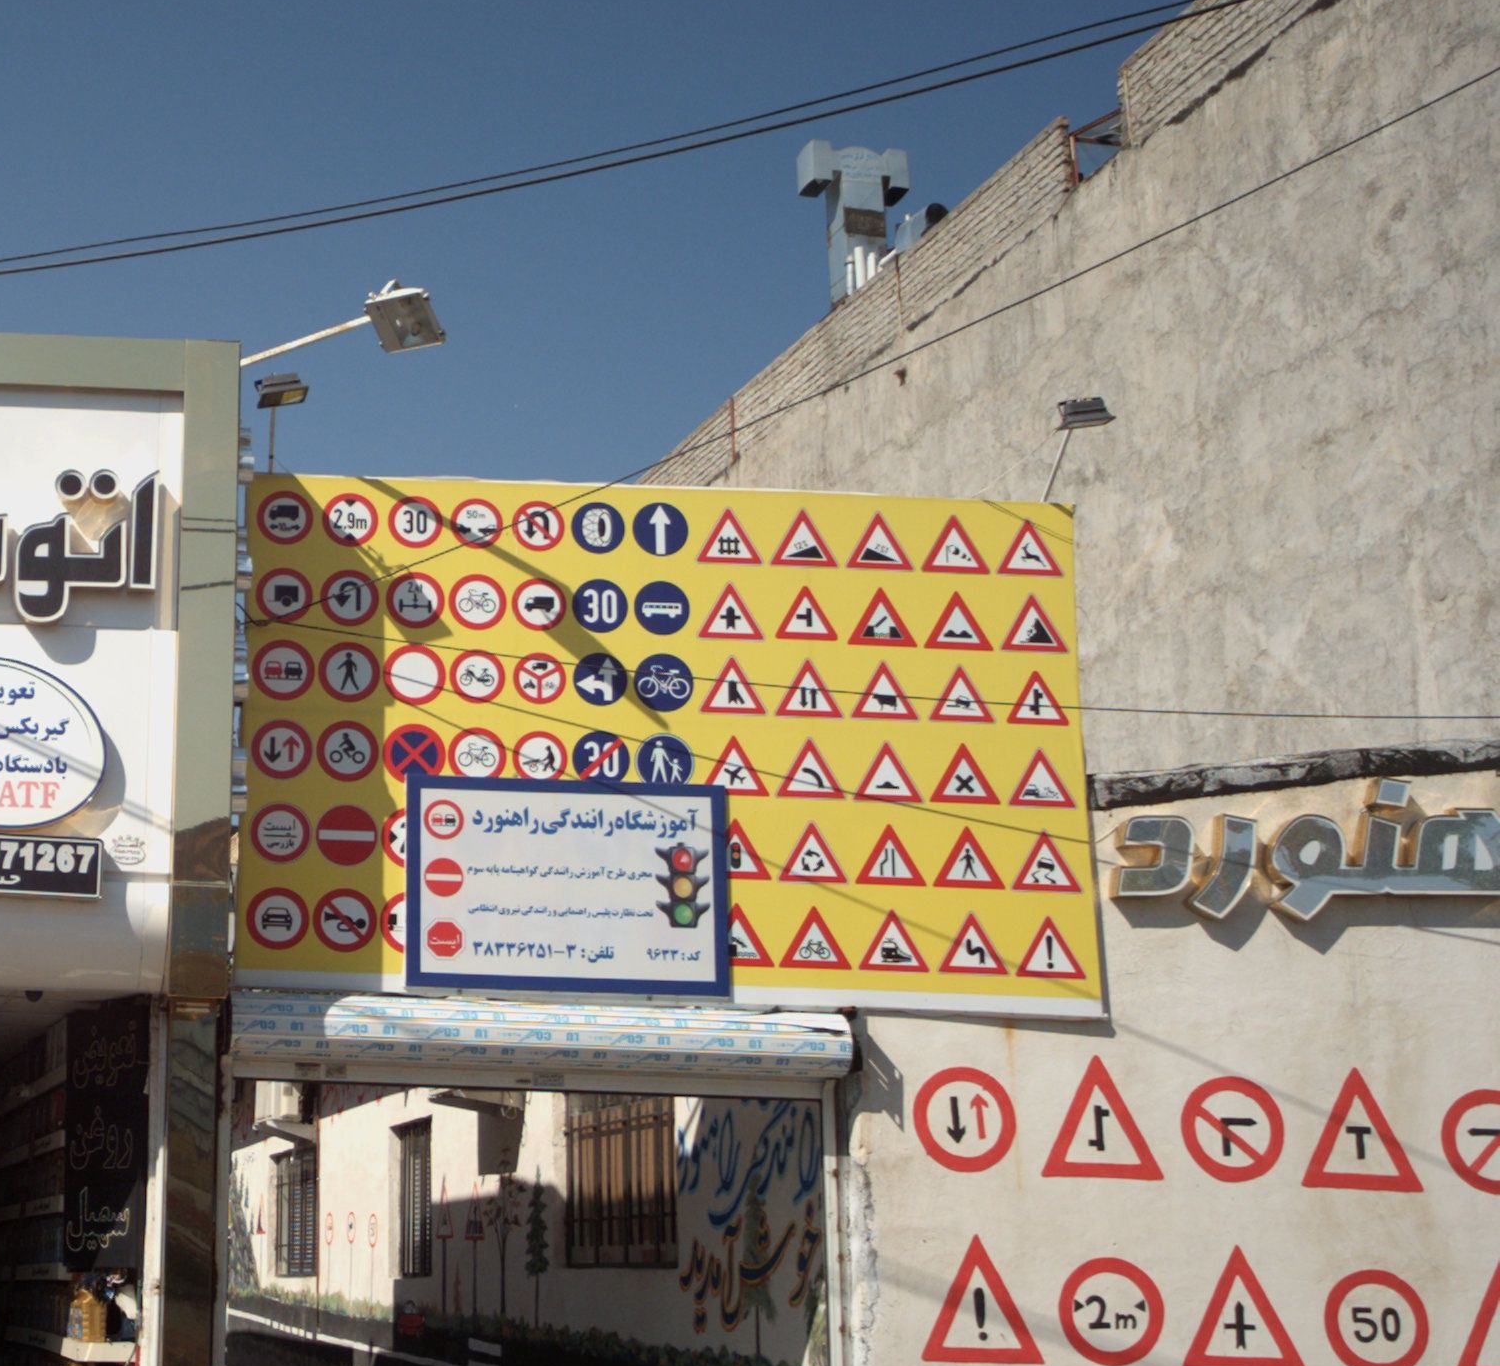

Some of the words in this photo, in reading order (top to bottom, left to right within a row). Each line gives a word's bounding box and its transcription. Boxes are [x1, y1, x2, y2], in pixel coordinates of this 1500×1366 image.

[403, 509, 428, 535] 30
[582, 588, 619, 624] 30
[583, 740, 620, 778] 30
[263, 818, 297, 836] ایست
[472, 806, 539, 834] راهنورد
[540, 806, 615, 837] رانندگی
[616, 807, 700, 838] آموزشگاه
[266, 838, 296, 850] بازرسی
[574, 865, 606, 880] آموزش
[69, 1104, 134, 1170] روغن
[65, 1186, 131, 1252] سهیل
[1352, 1306, 1402, 1344] 50
